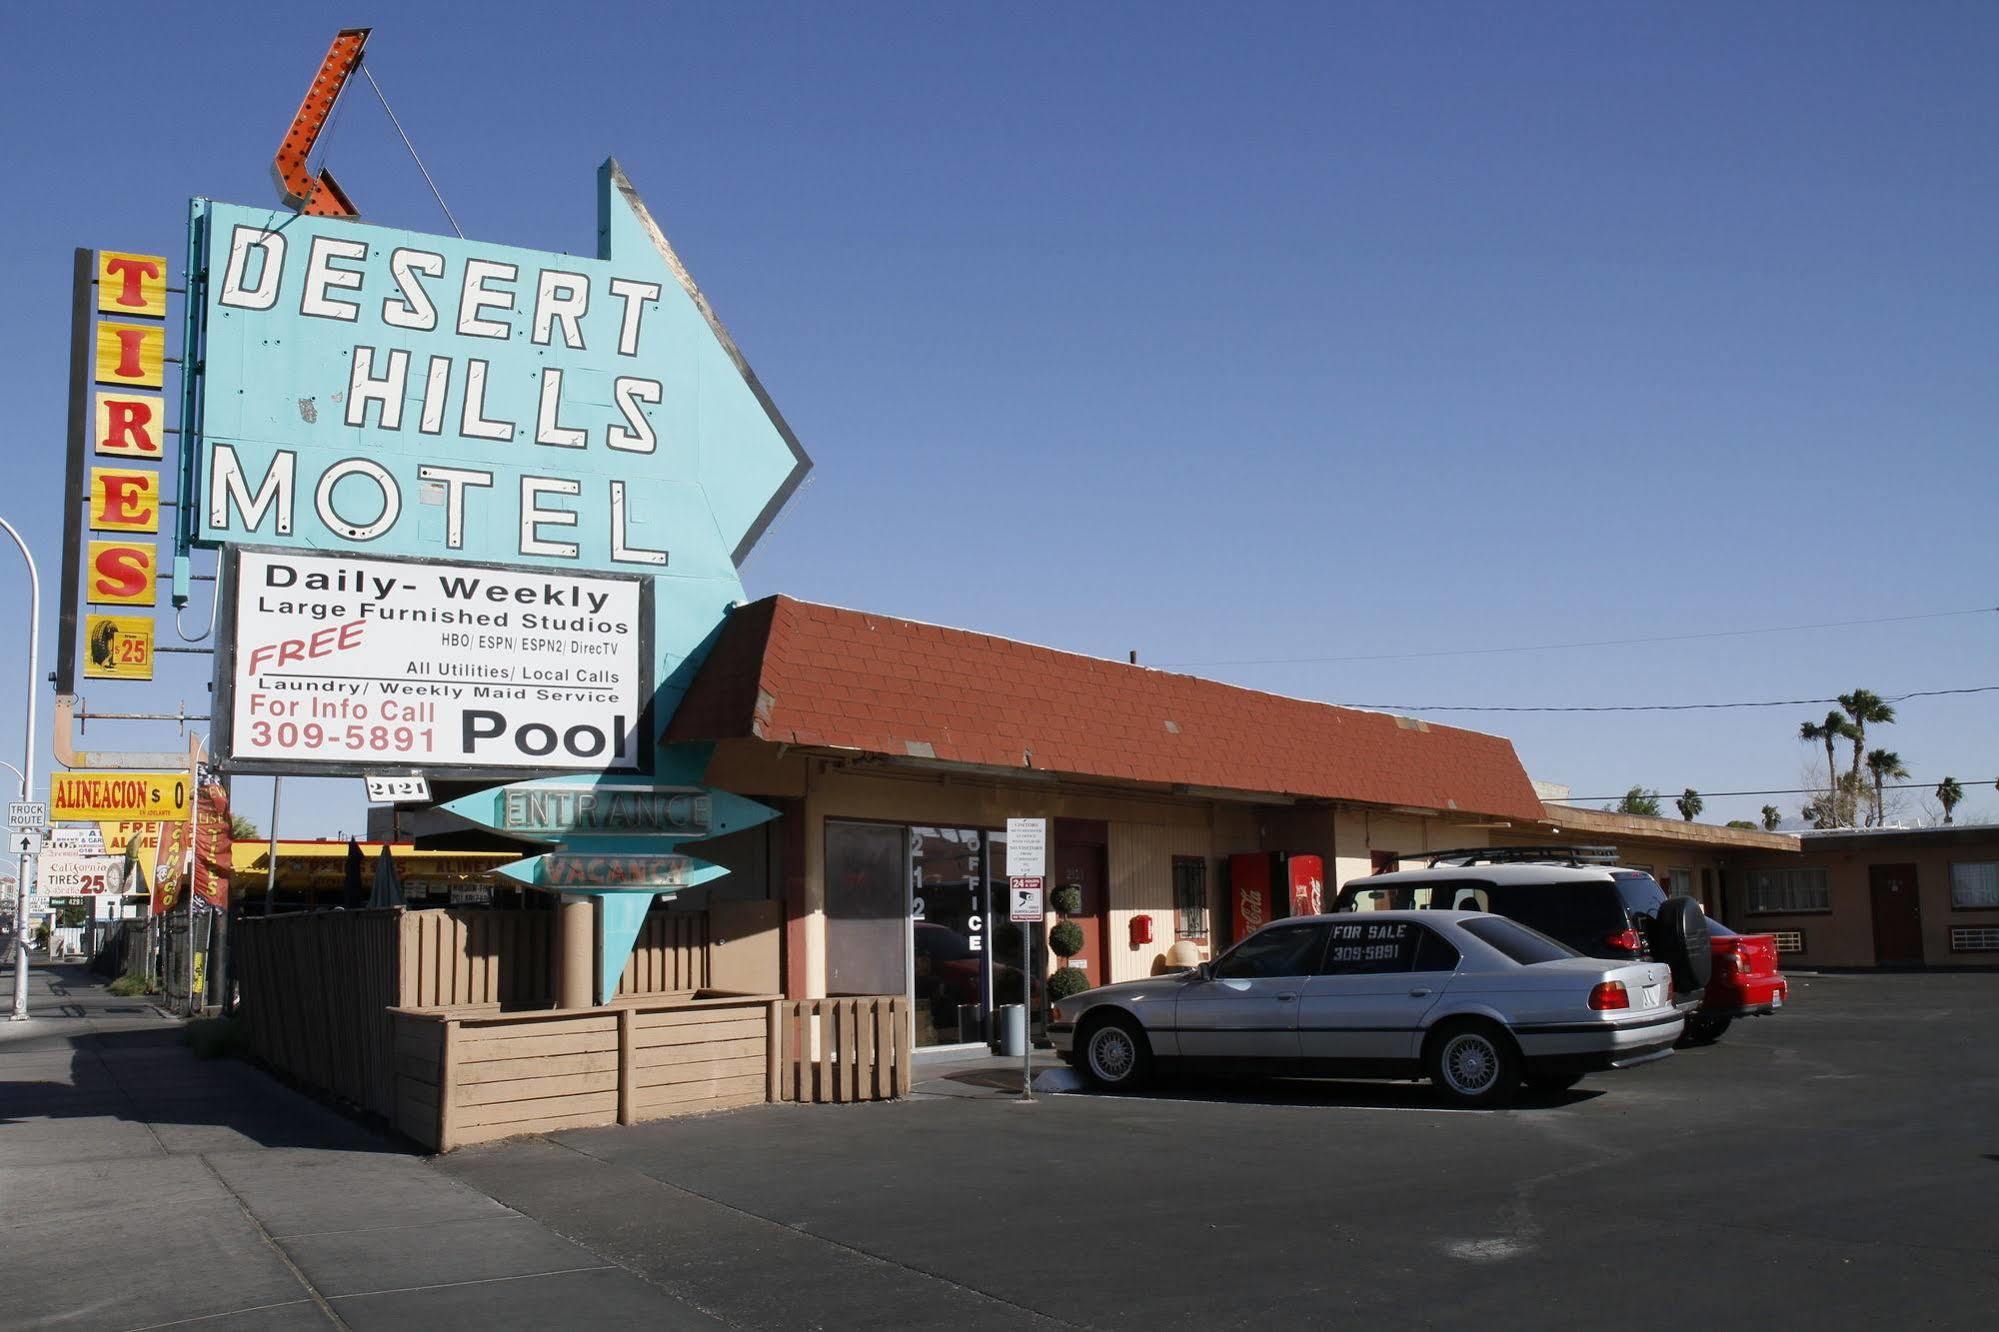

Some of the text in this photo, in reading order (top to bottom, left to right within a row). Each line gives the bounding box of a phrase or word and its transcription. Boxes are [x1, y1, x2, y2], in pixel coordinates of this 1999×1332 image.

[219, 225, 662, 357] DESERT
[344, 346, 662, 454] HILLS
[95, 258, 160, 598] TIRES
[209, 445, 668, 566] MOTEL
[266, 564, 609, 614] Daily- Weekly
[259, 597, 628, 634] Large Furnished Studios
[121, 640, 146, 663] 25
[249, 620, 366, 676] FREE
[571, 640, 619, 655] DirecTV
[407, 661, 429, 675] All
[523, 667, 569, 682] Local
[576, 669, 619, 684] Calls
[379, 682, 463, 699] Weekly
[474, 687, 526, 700] Maid
[537, 689, 619, 703] Service
[250, 694, 435, 722] For Info Call
[251, 709, 626, 758] 309-5891 Pool
[55, 780, 184, 809] ALINEACION $ 0
[370, 782, 424, 796] 2121
[11, 816, 43, 825] ROUTE
[506, 792, 713, 828] ENTRANCE
[48, 874, 80, 885] TIRES
[546, 857, 687, 883] VACANCY
[1013, 879, 1024, 888] 24
[967, 838, 982, 951] OFFICE
[1333, 924, 1407, 939] FOR SALE
